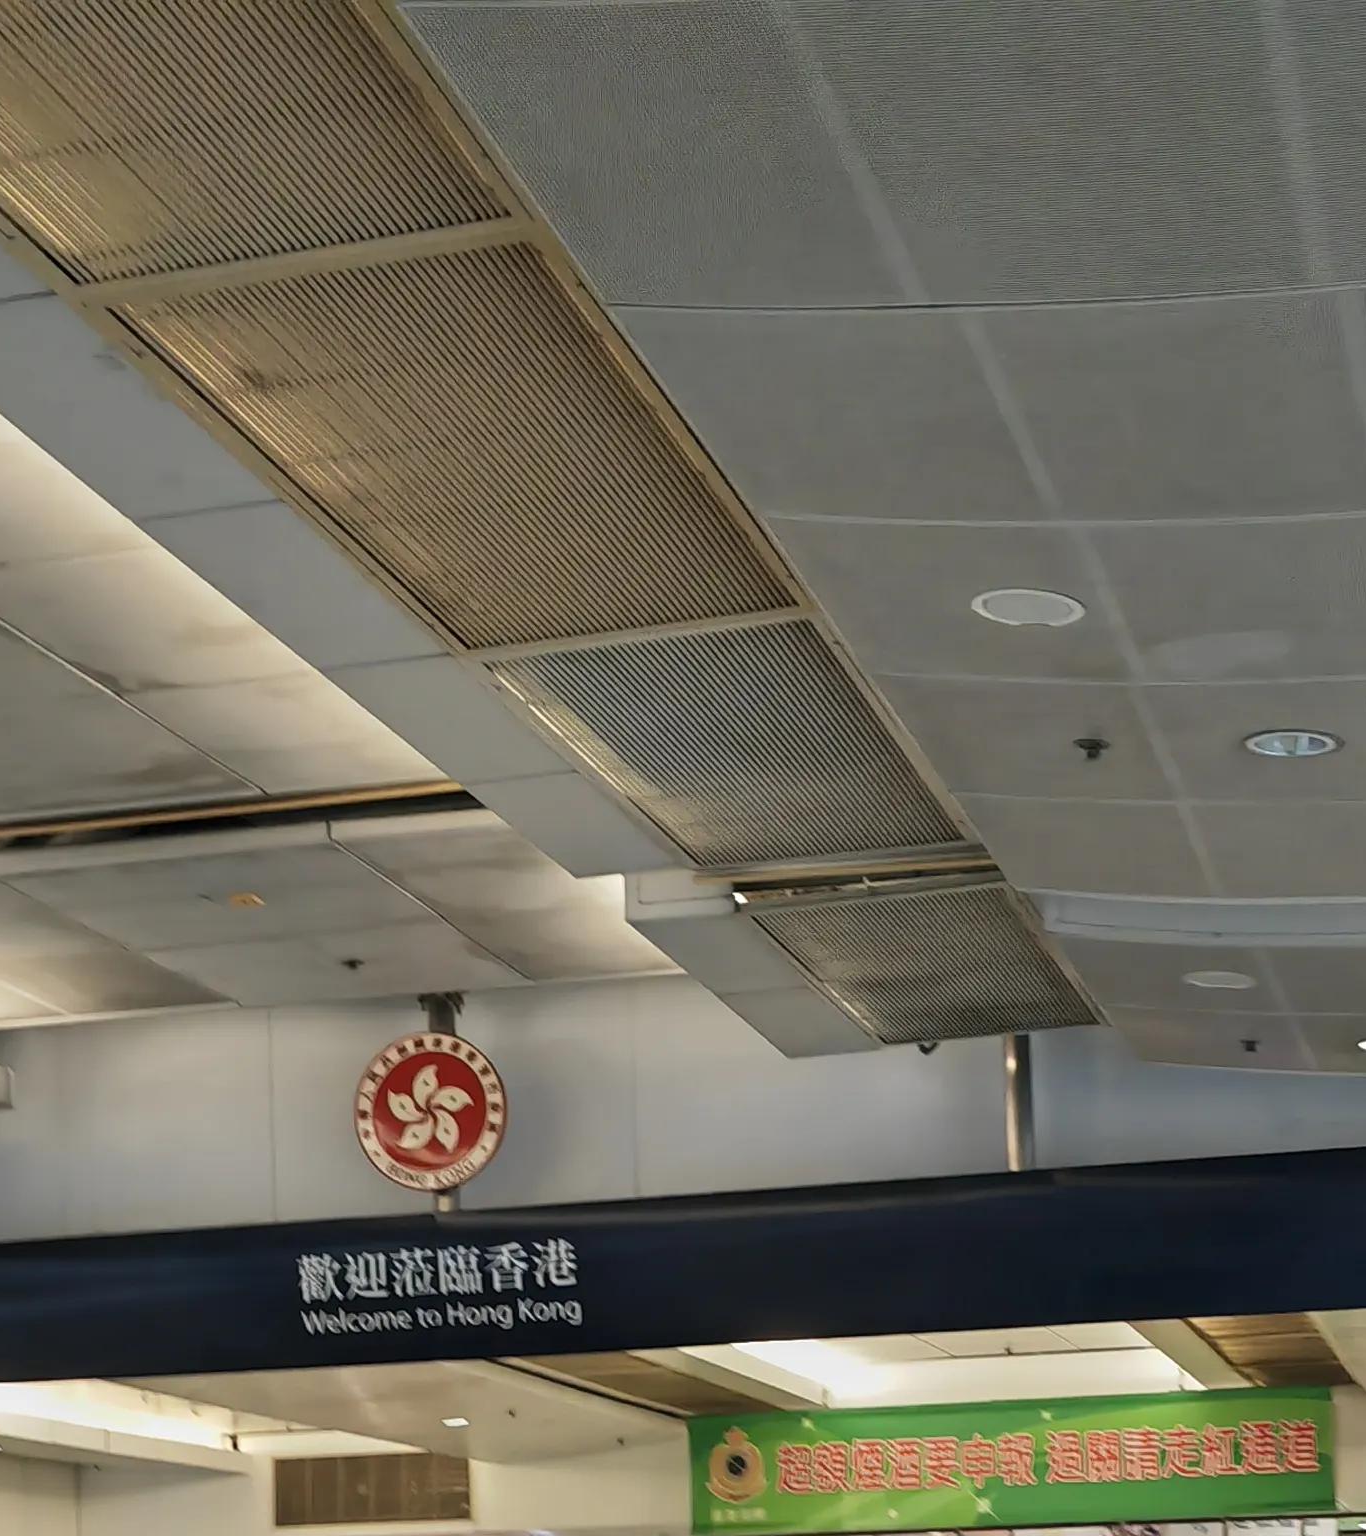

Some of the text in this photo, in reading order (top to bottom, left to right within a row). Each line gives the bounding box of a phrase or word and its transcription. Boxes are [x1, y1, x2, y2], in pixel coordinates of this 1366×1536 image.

[296, 1237, 579, 1304] 歡迎蒞臨香港
[300, 1297, 584, 1336] Welcome to Hong Kong
